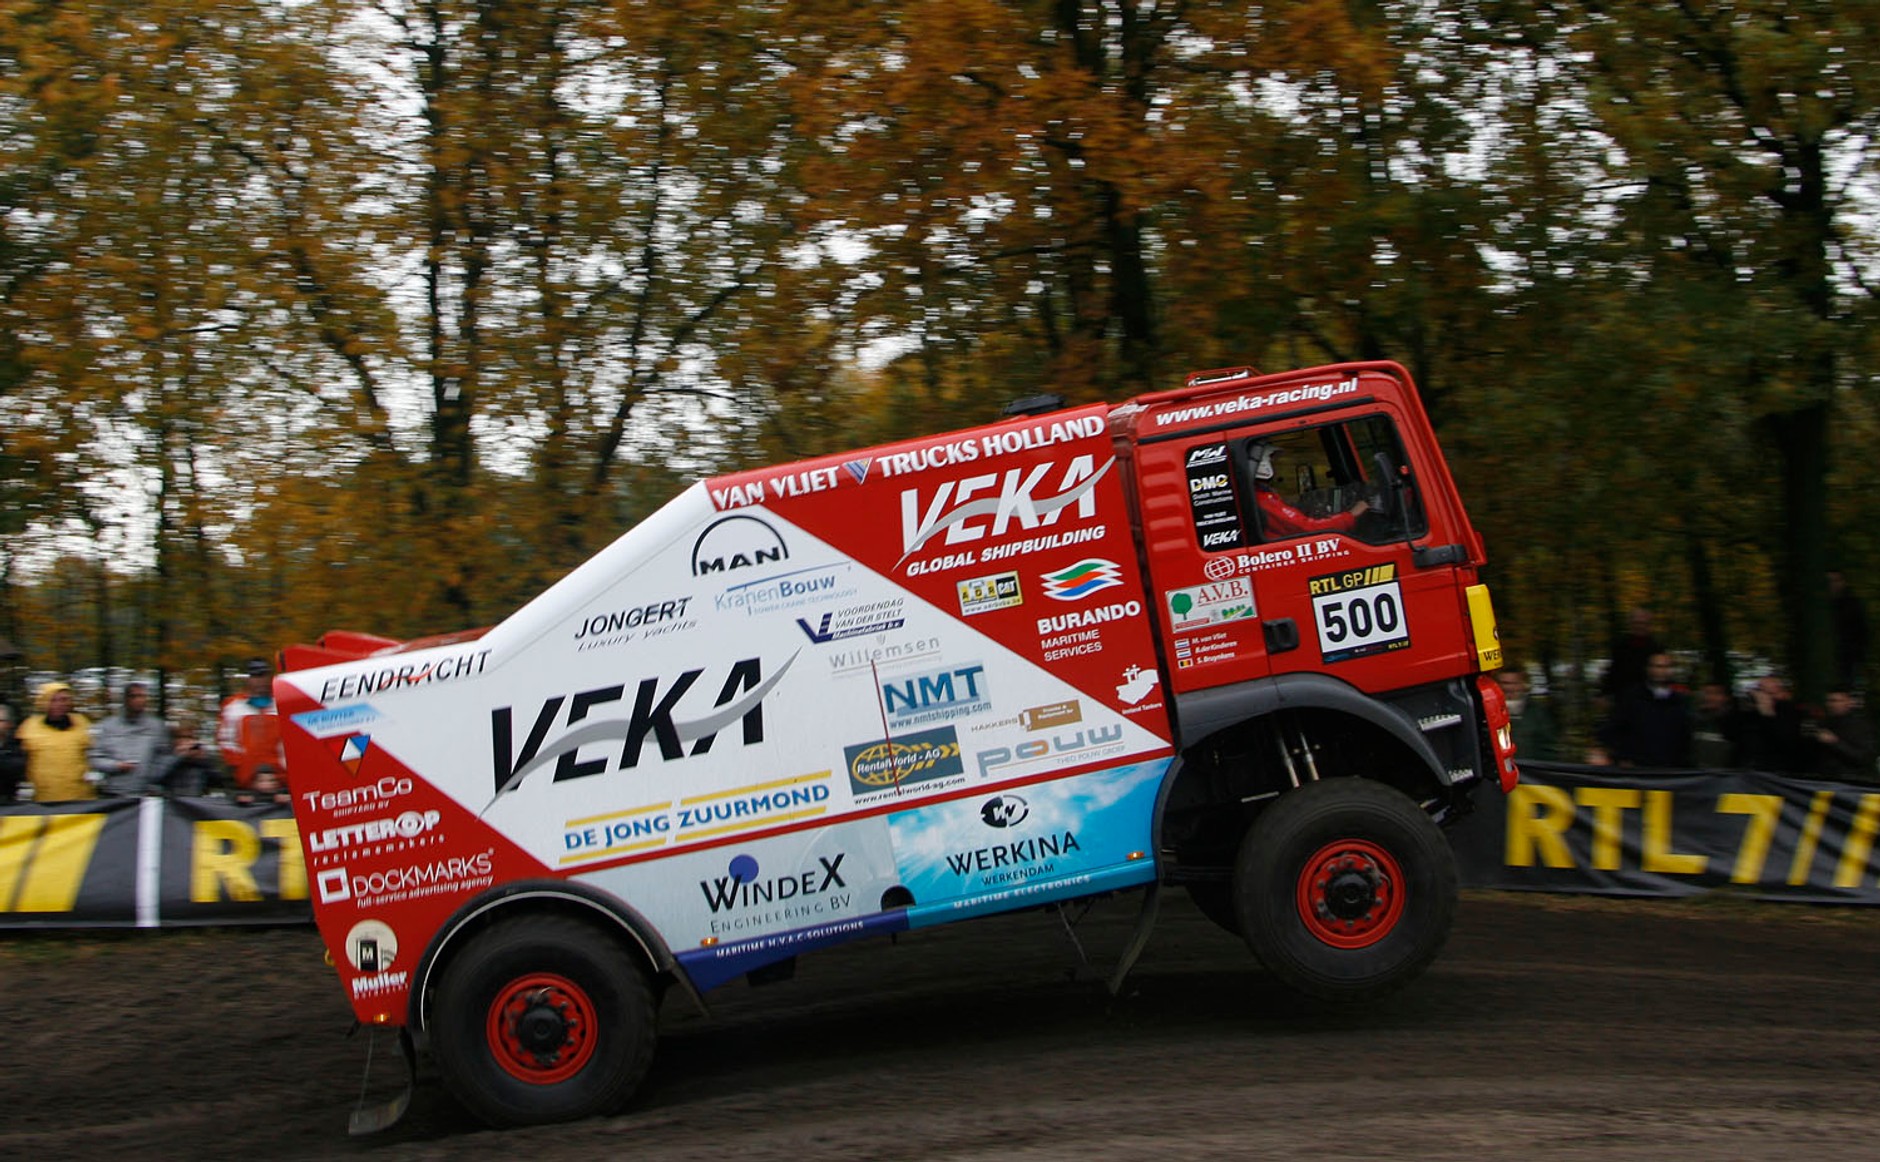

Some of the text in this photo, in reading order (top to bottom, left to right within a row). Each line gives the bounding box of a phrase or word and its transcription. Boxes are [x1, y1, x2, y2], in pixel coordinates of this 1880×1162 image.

[1156, 378, 1358, 426] www.veka-racing.nl
[712, 415, 1106, 511] VAN VLIET TRUCKS HOLLAND
[1190, 474, 1229, 492] DMC
[900, 454, 1097, 556] VEKA
[906, 525, 1106, 577] GLOBAL SHIPBUILDING
[1203, 529, 1241, 548] VEKA
[1236, 538, 1340, 568] Bolero II BV
[699, 546, 780, 575] MAN
[1239, 550, 1350, 574] CONTAINER SHIPPING
[714, 576, 836, 612] KranenBouw
[1198, 581, 1249, 604] A.V.B.
[1309, 572, 1364, 595] RTL GP
[574, 596, 693, 640] JONGERT
[835, 618, 854, 630] VAN
[837, 598, 905, 618] VOORDENDAG
[1037, 600, 1142, 635] BURANDO
[1321, 593, 1398, 643] 500
[828, 637, 941, 669] Willemsen
[1041, 629, 1100, 650] MARITIME
[1044, 641, 1102, 662] SERVICES
[1483, 649, 1502, 661] WE
[320, 649, 493, 704] EENDRACHT
[883, 665, 984, 713] NMT
[492, 657, 764, 797] VEKA
[889, 701, 992, 729] www.nmtshipping.com
[924, 748, 941, 760] AG
[303, 776, 413, 812] TeamCo
[309, 810, 441, 853] LETTEROP
[563, 784, 830, 851] DE JONG ZUURMOND
[1505, 784, 1785, 884] RTL 7
[190, 818, 311, 903] RT
[946, 831, 1081, 877] WERKINA
[352, 850, 493, 898] DOCKMARKS
[408, 880, 459, 900] advertising
[460, 874, 494, 892] agency
[953, 874, 1091, 909] MARITIME ELECTRONICS
[982, 864, 1055, 887] WERKENDAM
[710, 893, 851, 934] ENGINEERING BV
[362, 946, 374, 961] M
[715, 940, 765, 958] MARITIME
